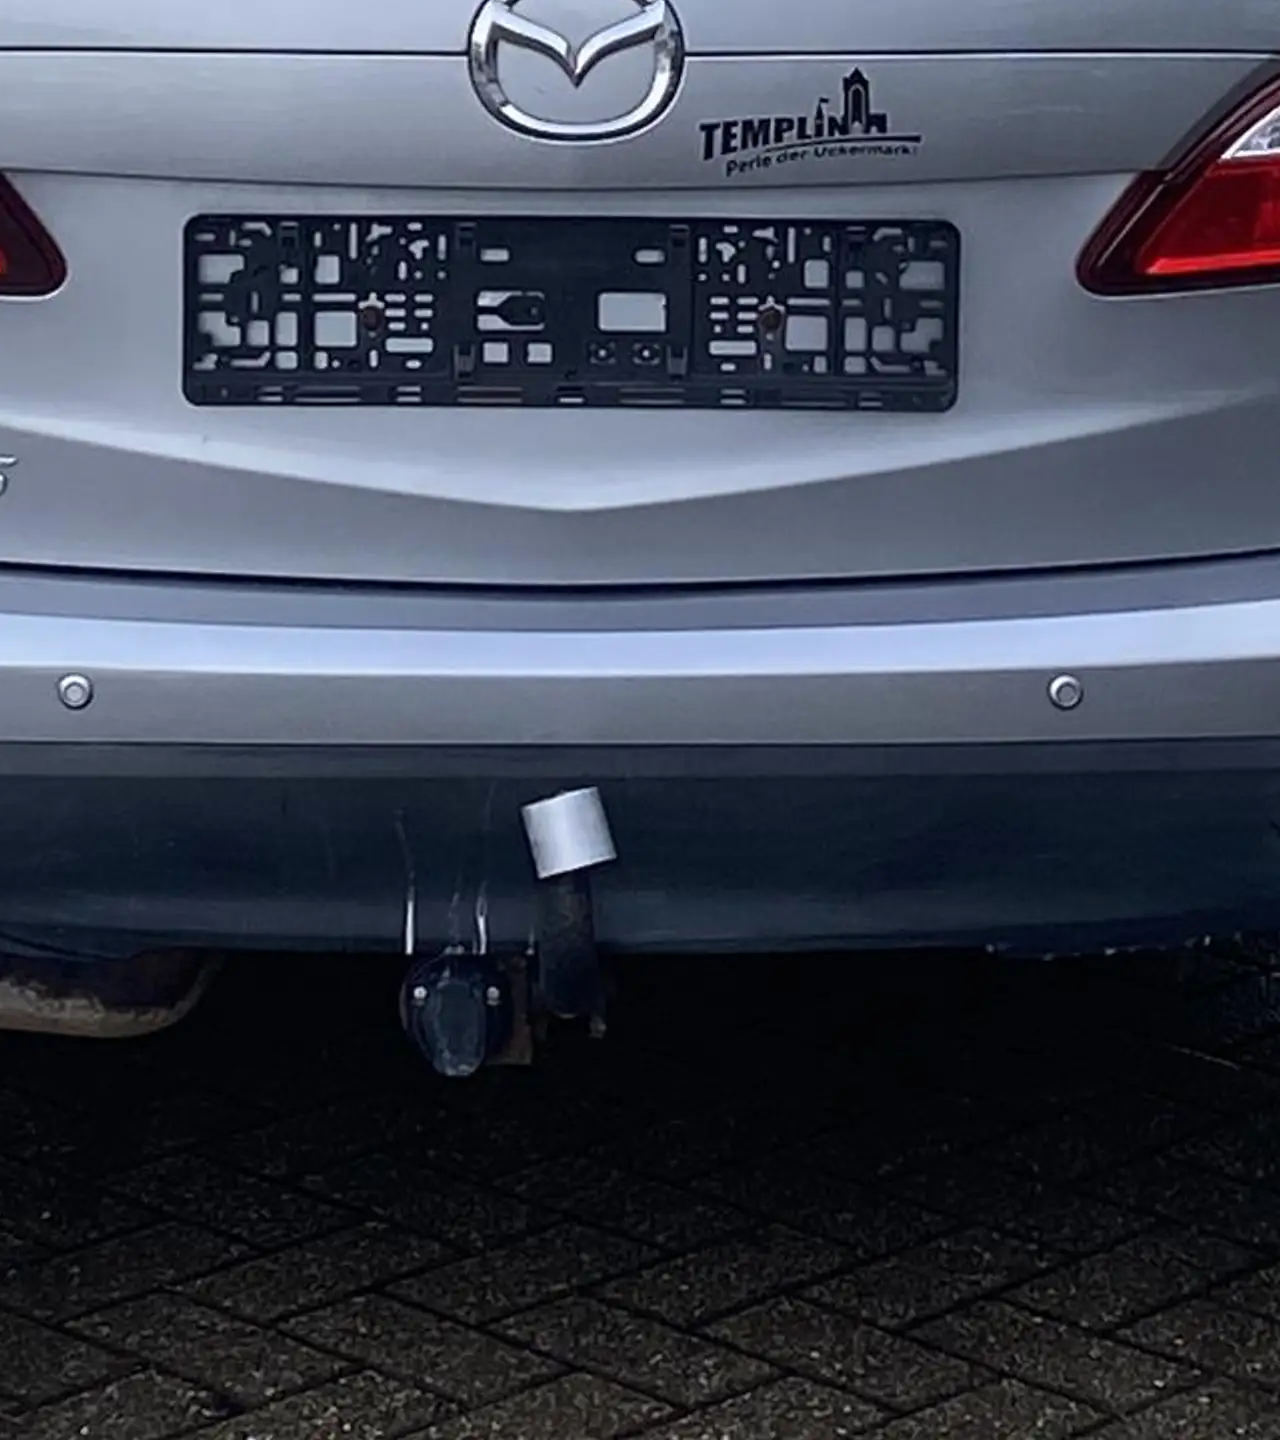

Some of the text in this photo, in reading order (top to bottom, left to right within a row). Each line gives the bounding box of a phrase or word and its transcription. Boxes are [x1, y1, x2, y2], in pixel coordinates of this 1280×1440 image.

[699, 106, 849, 160] TEMPLIN
[725, 156, 771, 178] Perle
[775, 148, 808, 165] der
